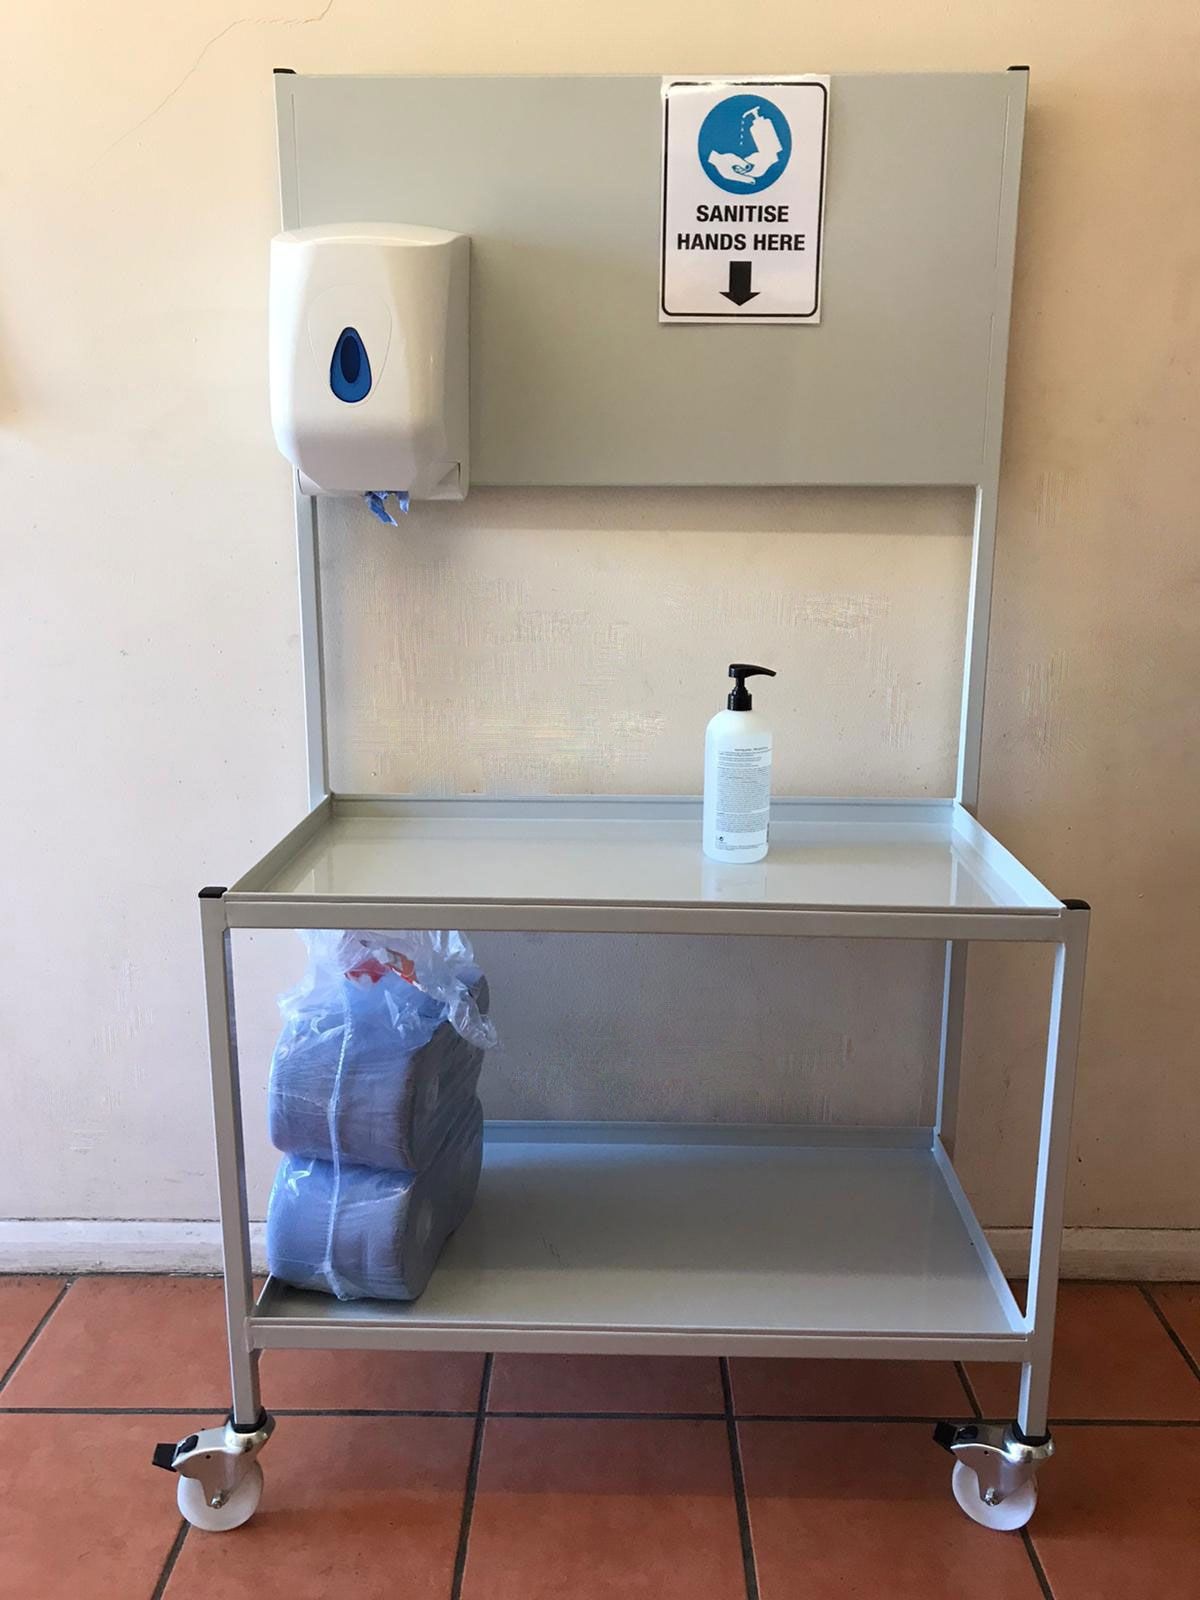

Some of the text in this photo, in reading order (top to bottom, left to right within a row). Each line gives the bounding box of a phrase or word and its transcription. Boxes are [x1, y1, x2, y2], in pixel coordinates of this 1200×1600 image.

[696, 204, 789, 223] SANITISE
[677, 233, 806, 251] HANDS HERE
